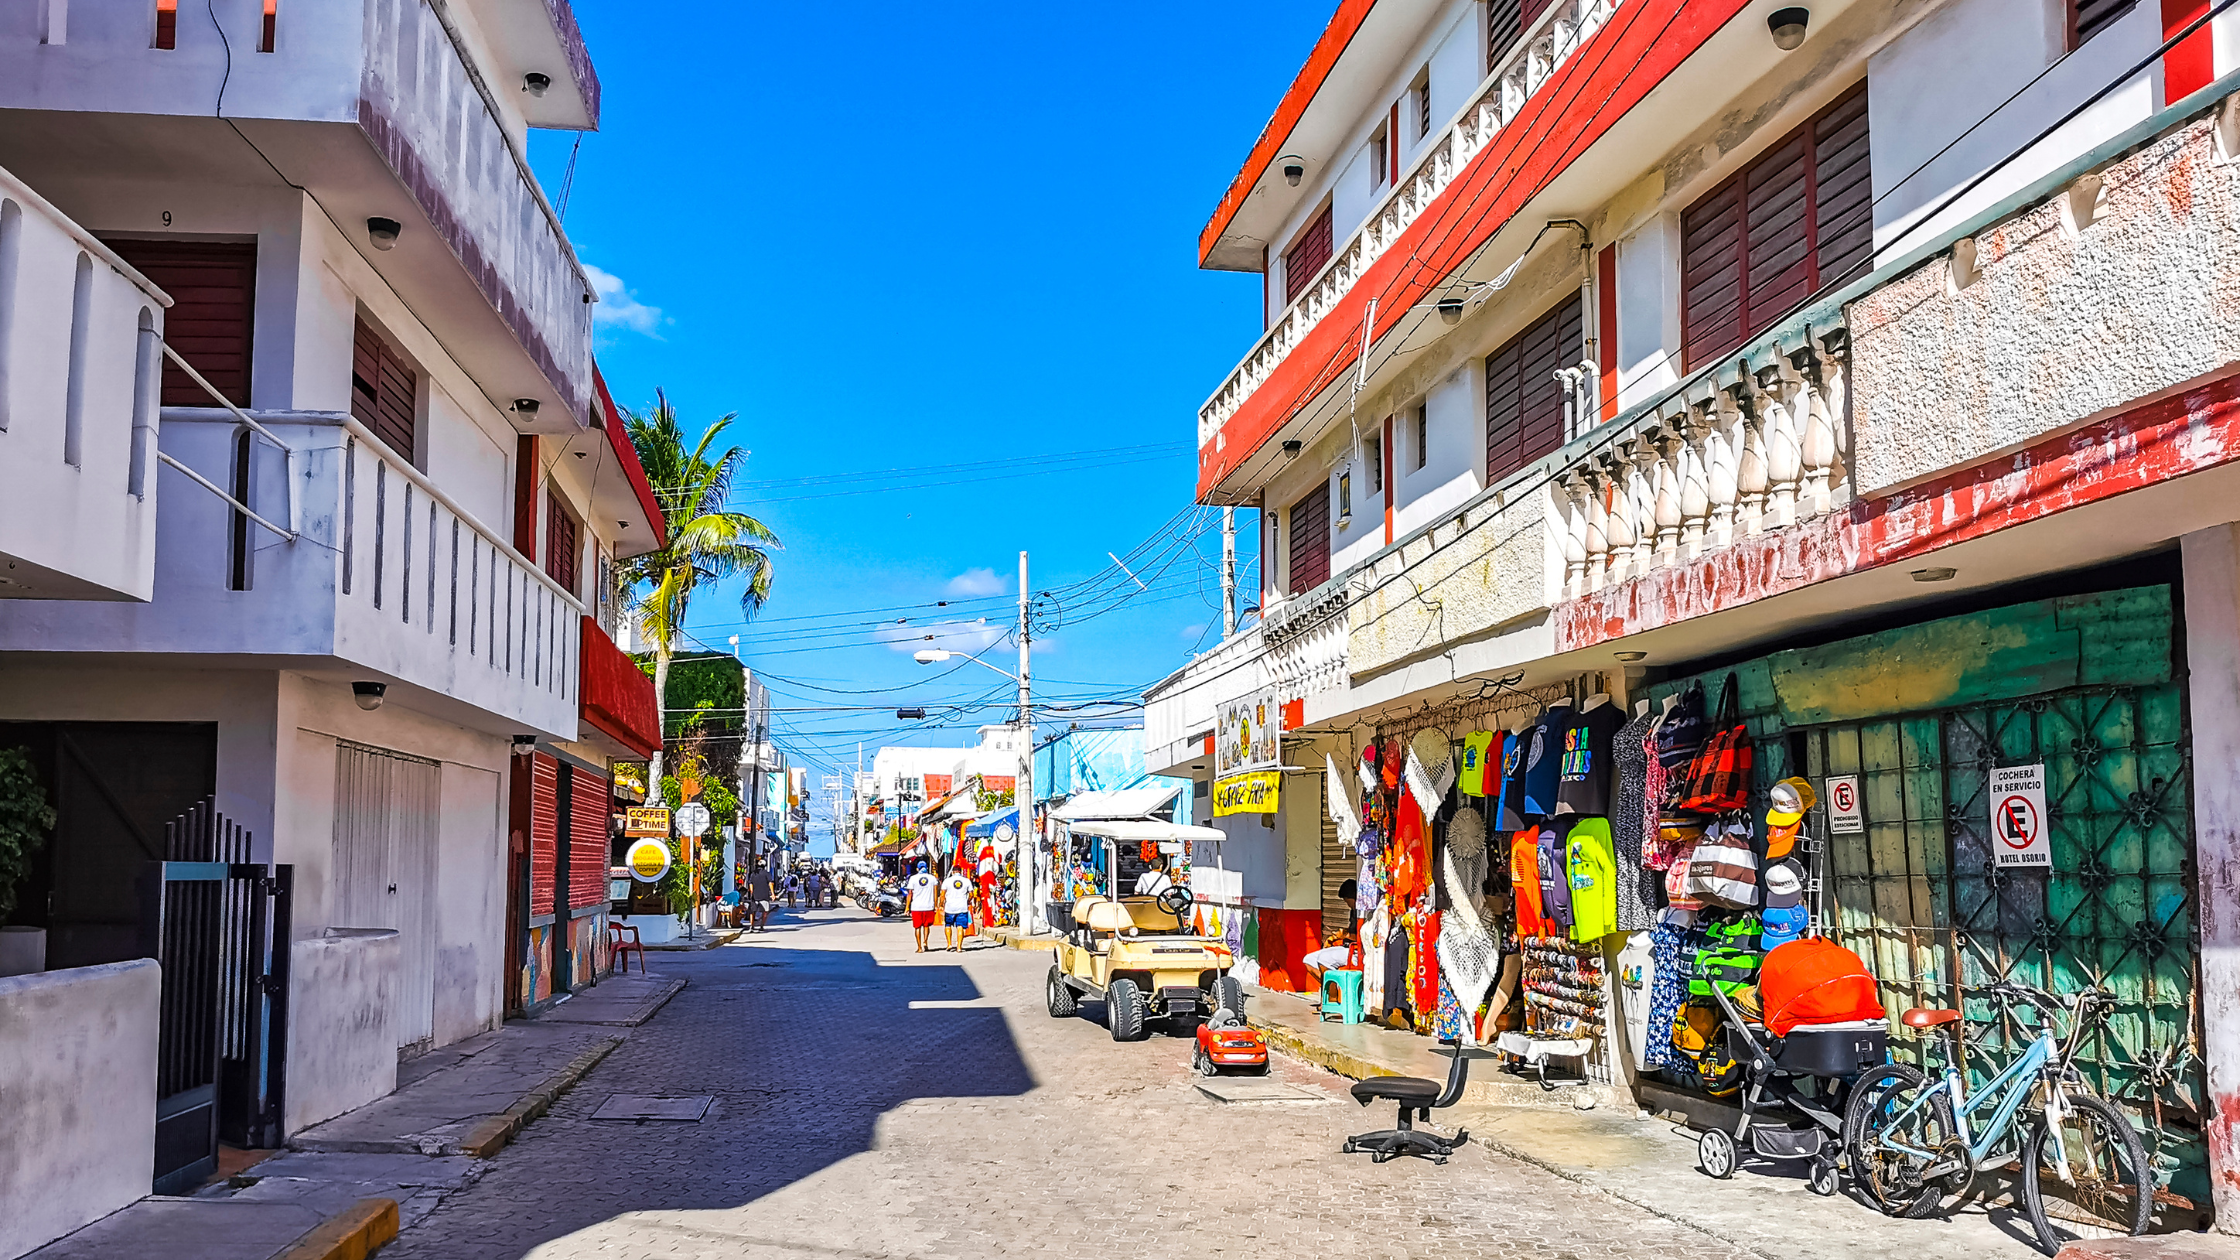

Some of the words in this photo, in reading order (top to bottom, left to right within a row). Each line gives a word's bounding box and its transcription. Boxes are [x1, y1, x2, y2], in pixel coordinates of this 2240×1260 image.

[161, 210, 173, 227] 9
[1998, 769, 2035, 781] COCHERA
[1993, 785, 2003, 793] EN
[2004, 781, 2041, 792] SERVICIO
[630, 810, 666, 818] COFFEE
[2006, 806, 2028, 839] E
[2000, 855, 2020, 863] HOTEL
[2021, 853, 2046, 863] OSORIO
